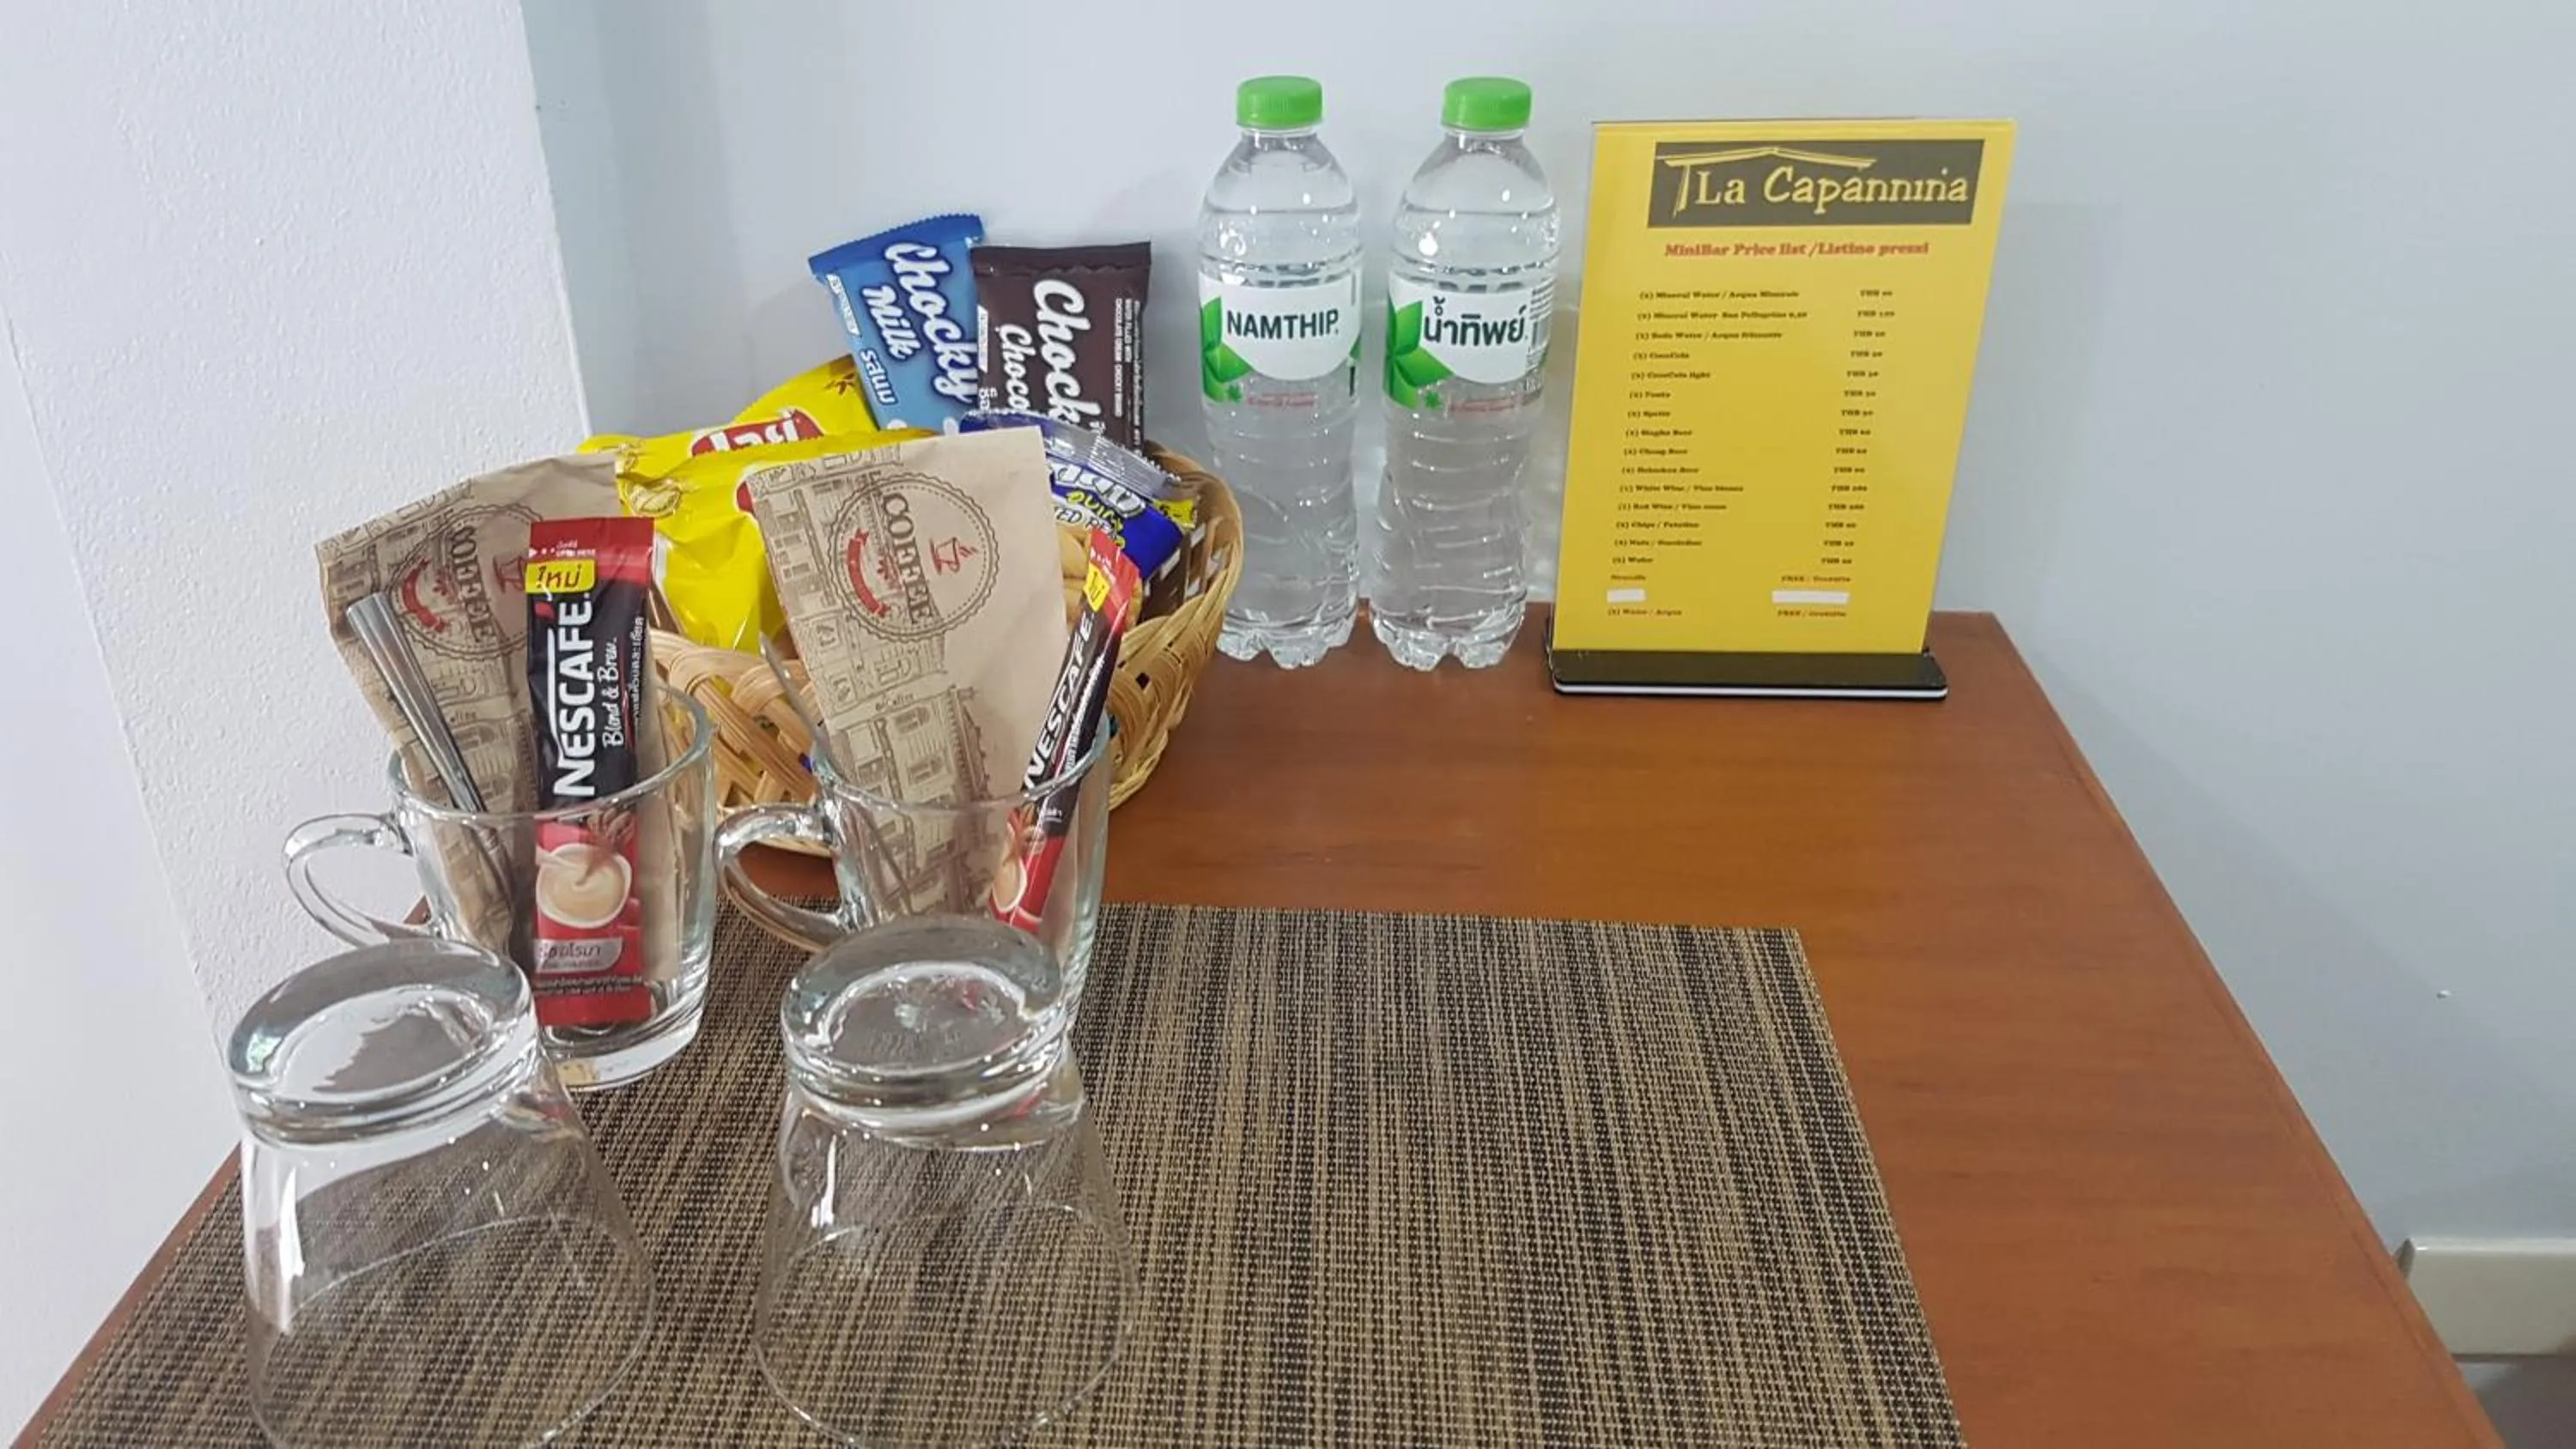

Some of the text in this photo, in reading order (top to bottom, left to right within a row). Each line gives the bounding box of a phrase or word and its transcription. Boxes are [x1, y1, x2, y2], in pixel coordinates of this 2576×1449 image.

[1694, 166, 1969, 215] La Capannina
[1732, 242, 1776, 257] Price
[1778, 242, 1807, 256] list
[861, 284, 921, 360] Milk
[884, 242, 979, 403] Chocky
[1033, 279, 1102, 424] Chock
[860, 349, 897, 404] รสนม
[448, 524, 498, 644] COFFEE
[882, 491, 934, 626] COFFEE
[605, 683, 620, 700] &
